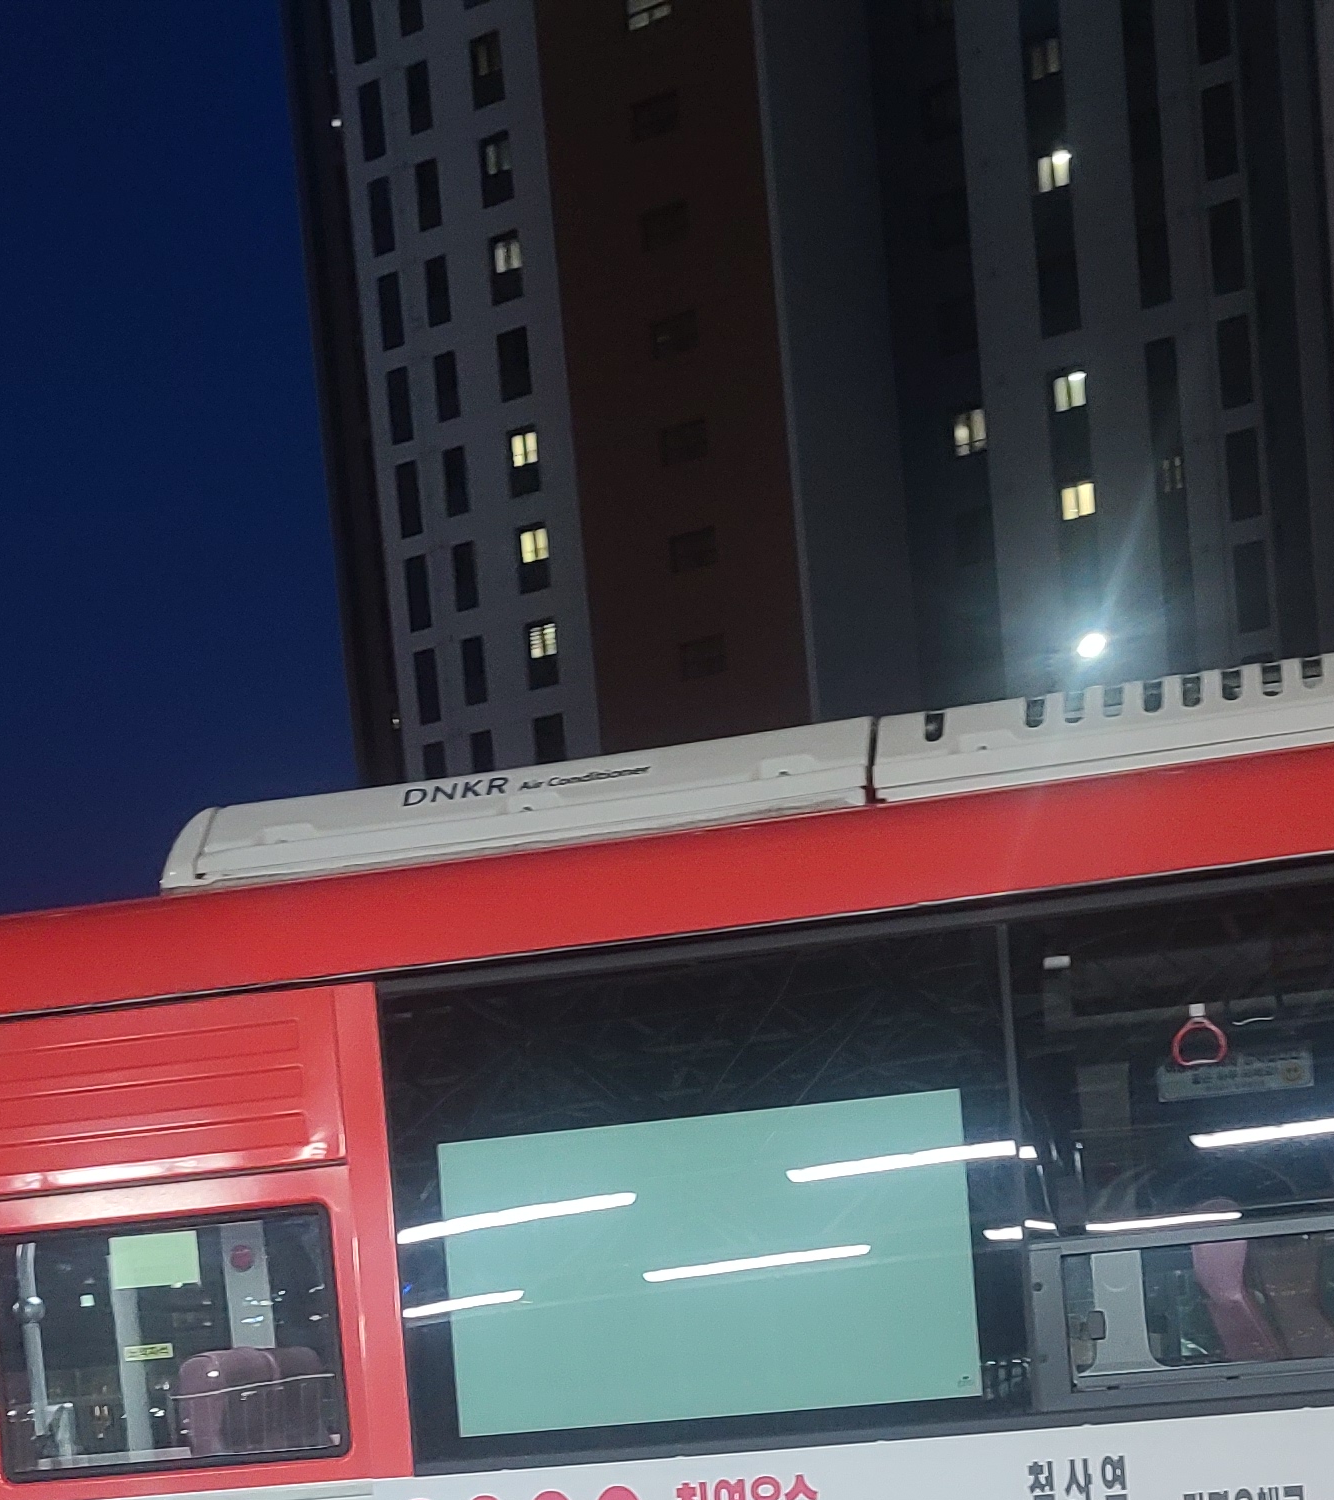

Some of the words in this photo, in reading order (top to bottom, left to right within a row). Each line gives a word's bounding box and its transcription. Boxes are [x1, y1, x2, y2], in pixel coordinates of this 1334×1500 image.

[403, 777, 509, 806] DNKR
[519, 780, 545, 791] Air
[549, 766, 651, 787] Conditioner
